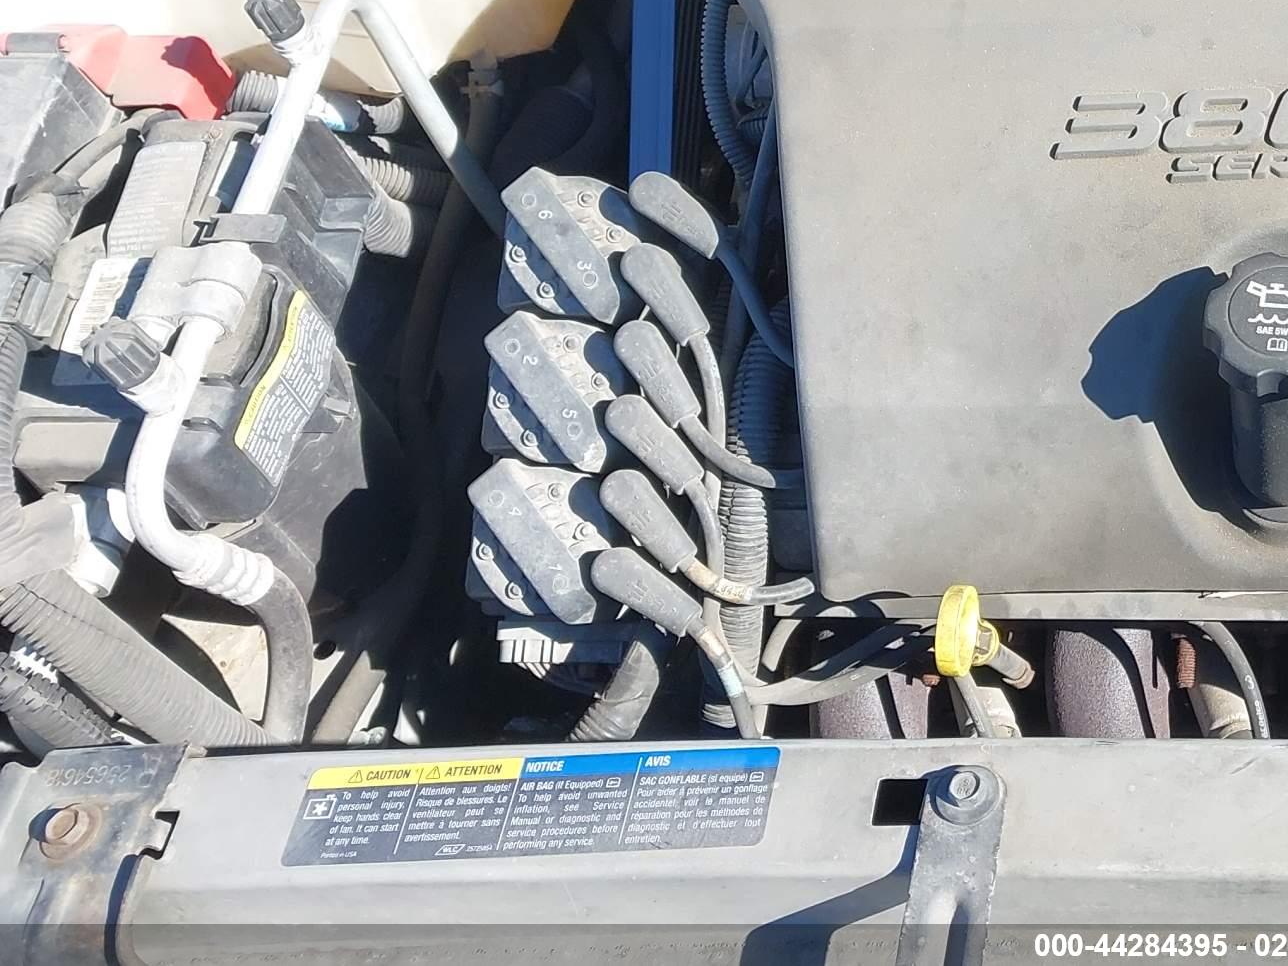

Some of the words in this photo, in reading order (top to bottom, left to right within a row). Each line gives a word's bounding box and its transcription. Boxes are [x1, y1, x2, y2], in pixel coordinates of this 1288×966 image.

[538, 210, 553, 220] 6
[576, 260, 592, 271] 3
[1256, 325, 1274, 335] SAE
[522, 355, 539, 366] 2
[562, 408, 577, 419] 5
[525, 760, 565, 773] NOTICE
[644, 755, 671, 767] AVIS
[366, 769, 411, 781] CAUTION
[444, 764, 503, 777] ATTENTION
[520, 781, 535, 791] AIR
[536, 781, 554, 790] BAG
[564, 778, 603, 790] Equipped)
[640, 776, 656, 785] SAC
[658, 774, 707, 784] GONFLABLE
[342, 791, 352, 800] To
[360, 790, 379, 800] help
[387, 789, 411, 798] avoid
[420, 786, 456, 796] Attention
[462, 786, 478, 794] aux
[483, 783, 512, 793] doigts!
[636, 787, 655, 797] Pour
[657, 786, 676, 796] aider
[686, 785, 719, 796] prévenir
[721, 785, 732, 794] un
[733, 783, 768, 795] gonflage
[416, 798, 442, 808] Risque
[444, 797, 455, 806] de
[497, 794, 508, 803] Le
[518, 793, 527, 803] To
[533, 792, 552, 802] help
[558, 791, 581, 800] avoid
[587, 789, 628, 799] unwanted
[683, 798, 699, 807] voir
[705, 797, 713, 806] le
[719, 796, 750, 805] manuel
[755, 795, 766, 804] de
[337, 802, 373, 812] personal
[563, 804, 580, 812] see
[592, 801, 625, 810] Service
[333, 813, 353, 823] keep
[356, 812, 380, 822] hands
[382, 811, 402, 820] clear
[412, 809, 456, 819] ventilateur
[464, 808, 485, 817] peut
[494, 807, 505, 815] se
[510, 815, 541, 826] Manual
[545, 816, 556, 824] or
[559, 813, 601, 825] diagnostic
[605, 812, 622, 821] and
[630, 810, 671, 821] réparation
[674, 809, 693, 820] pour
[696, 808, 708, 818] les
[710, 807, 750, 817] méthodes
[752, 806, 763, 815] de
[329, 825, 339, 834] of
[364, 824, 379, 833] can
[380, 823, 400, 832] start
[408, 821, 435, 831] mettre
[448, 819, 479, 829] tourner
[480, 818, 501, 827] sans
[627, 821, 671, 833] diagnostic
[677, 821, 686, 830] et
[744, 818, 762, 827] tout
[506, 828, 537, 838] service
[540, 826, 588, 837] procedures
[592, 824, 619, 834] before
[325, 837, 334, 846] at
[335, 838, 349, 847] any
[503, 839, 547, 851] performing
[548, 839, 562, 849] any
